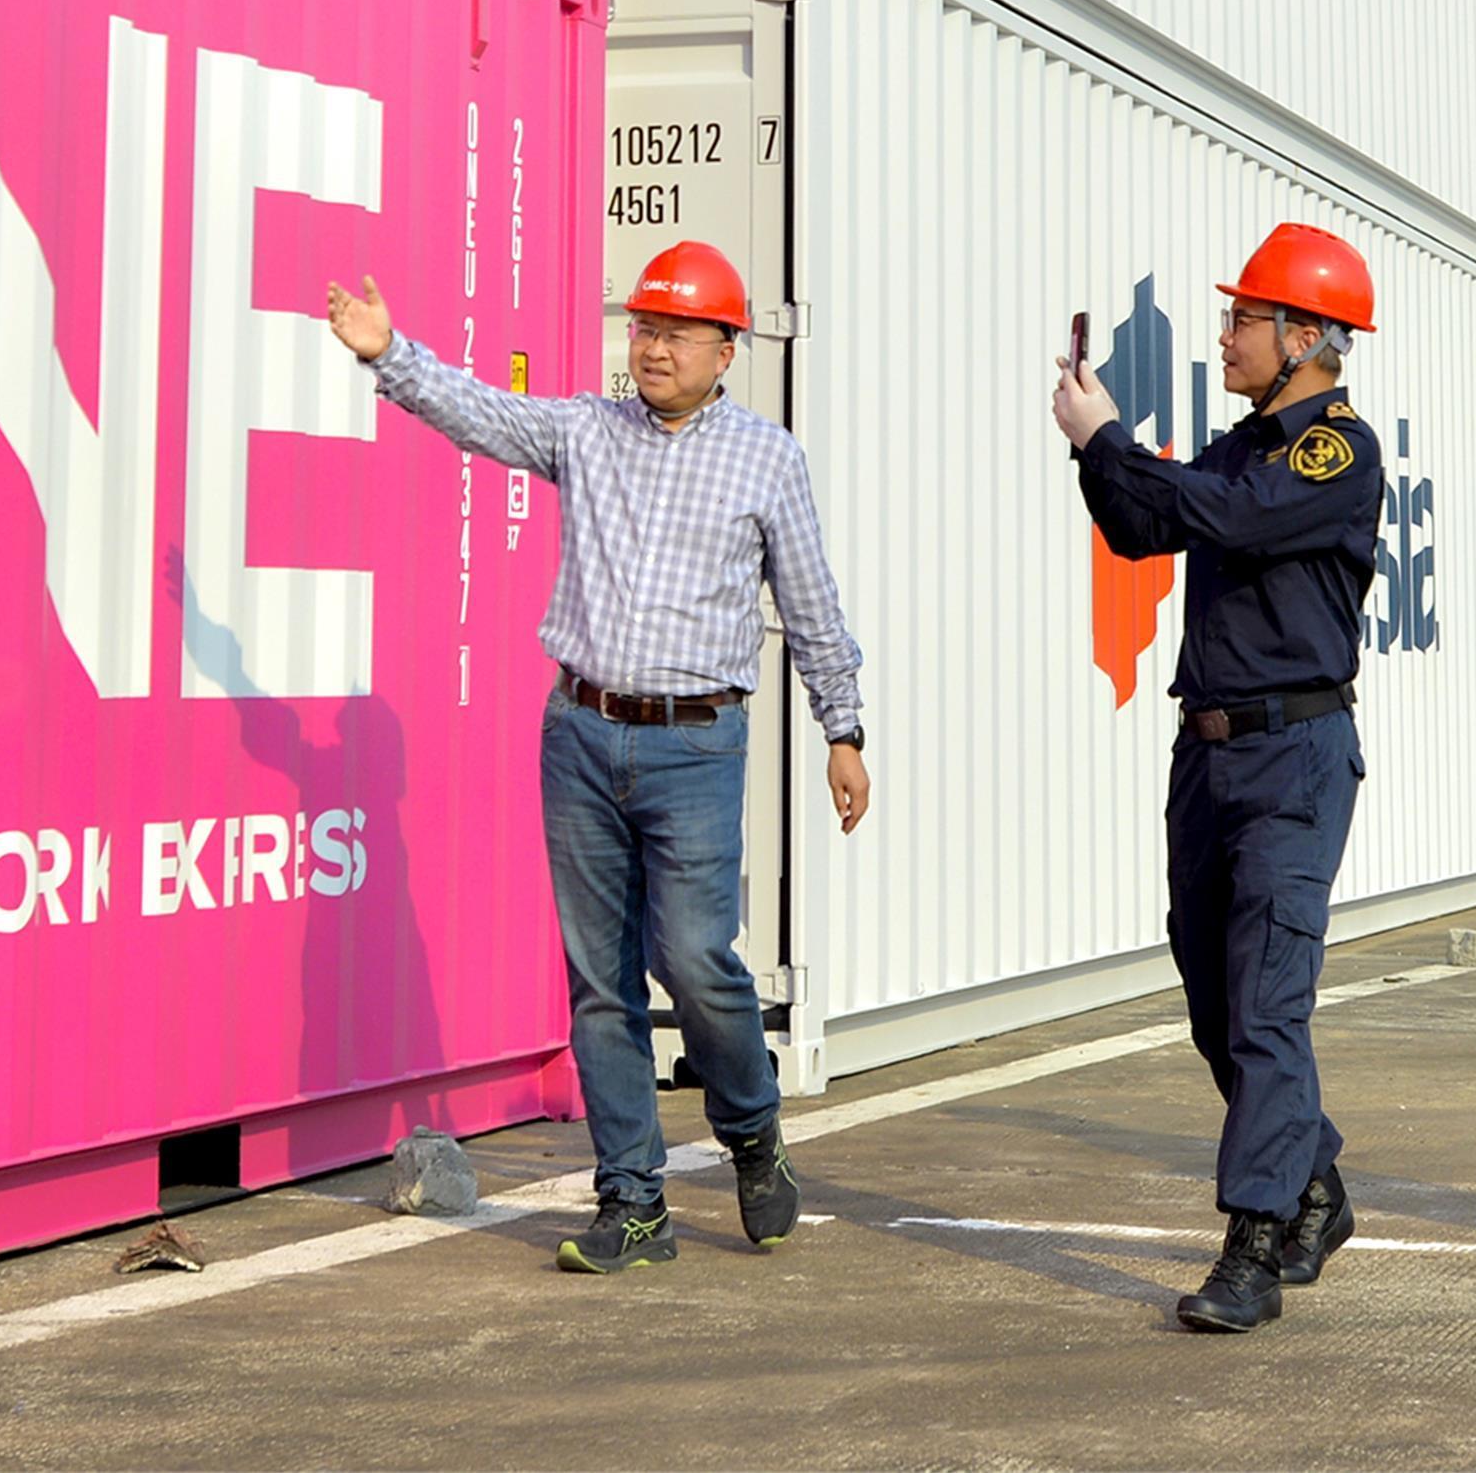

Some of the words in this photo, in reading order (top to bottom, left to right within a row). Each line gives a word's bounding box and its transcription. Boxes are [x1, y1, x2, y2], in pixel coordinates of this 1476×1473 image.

[464, 101, 478, 298] ONEU
[511, 117, 523, 309] 22G1
[607, 184, 680, 226] 45G1
[611, 122, 722, 167] 105212
[760, 120, 778, 160] 7
[459, 316, 475, 624] 2347
